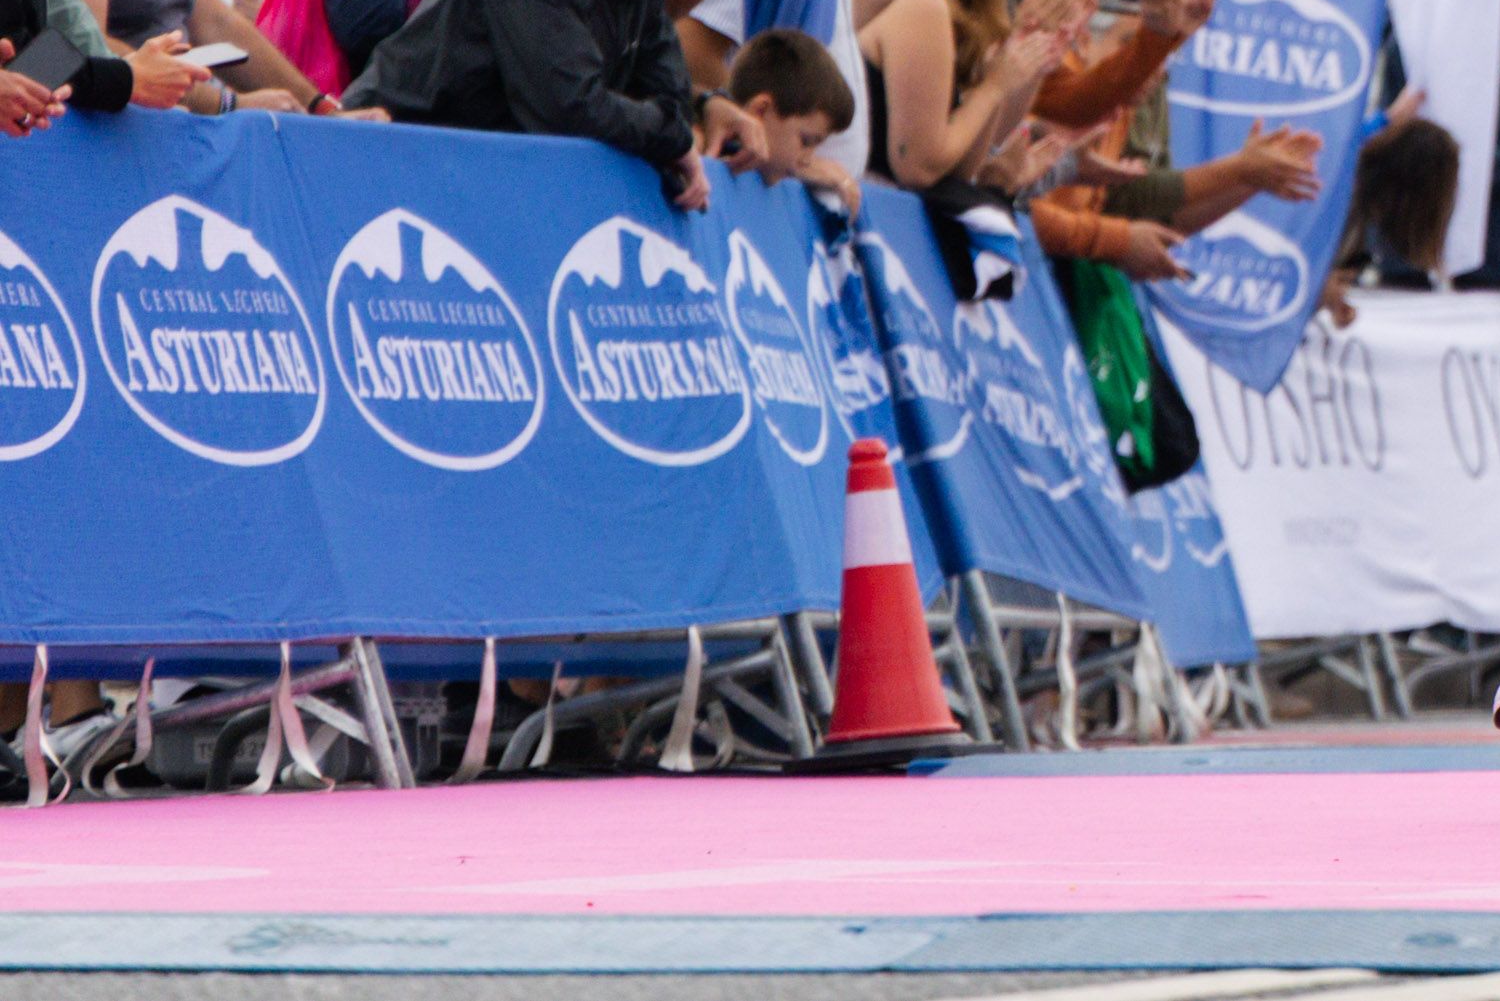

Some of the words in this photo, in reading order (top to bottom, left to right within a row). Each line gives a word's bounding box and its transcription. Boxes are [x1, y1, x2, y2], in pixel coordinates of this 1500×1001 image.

[139, 287, 218, 313] CENTRAL
[367, 297, 438, 324] CENTRAL
[438, 301, 507, 327] LECHERA
[587, 303, 655, 328] CENTRAL
[117, 292, 317, 395] ASTURIANA
[348, 301, 534, 403] ASTURIANA
